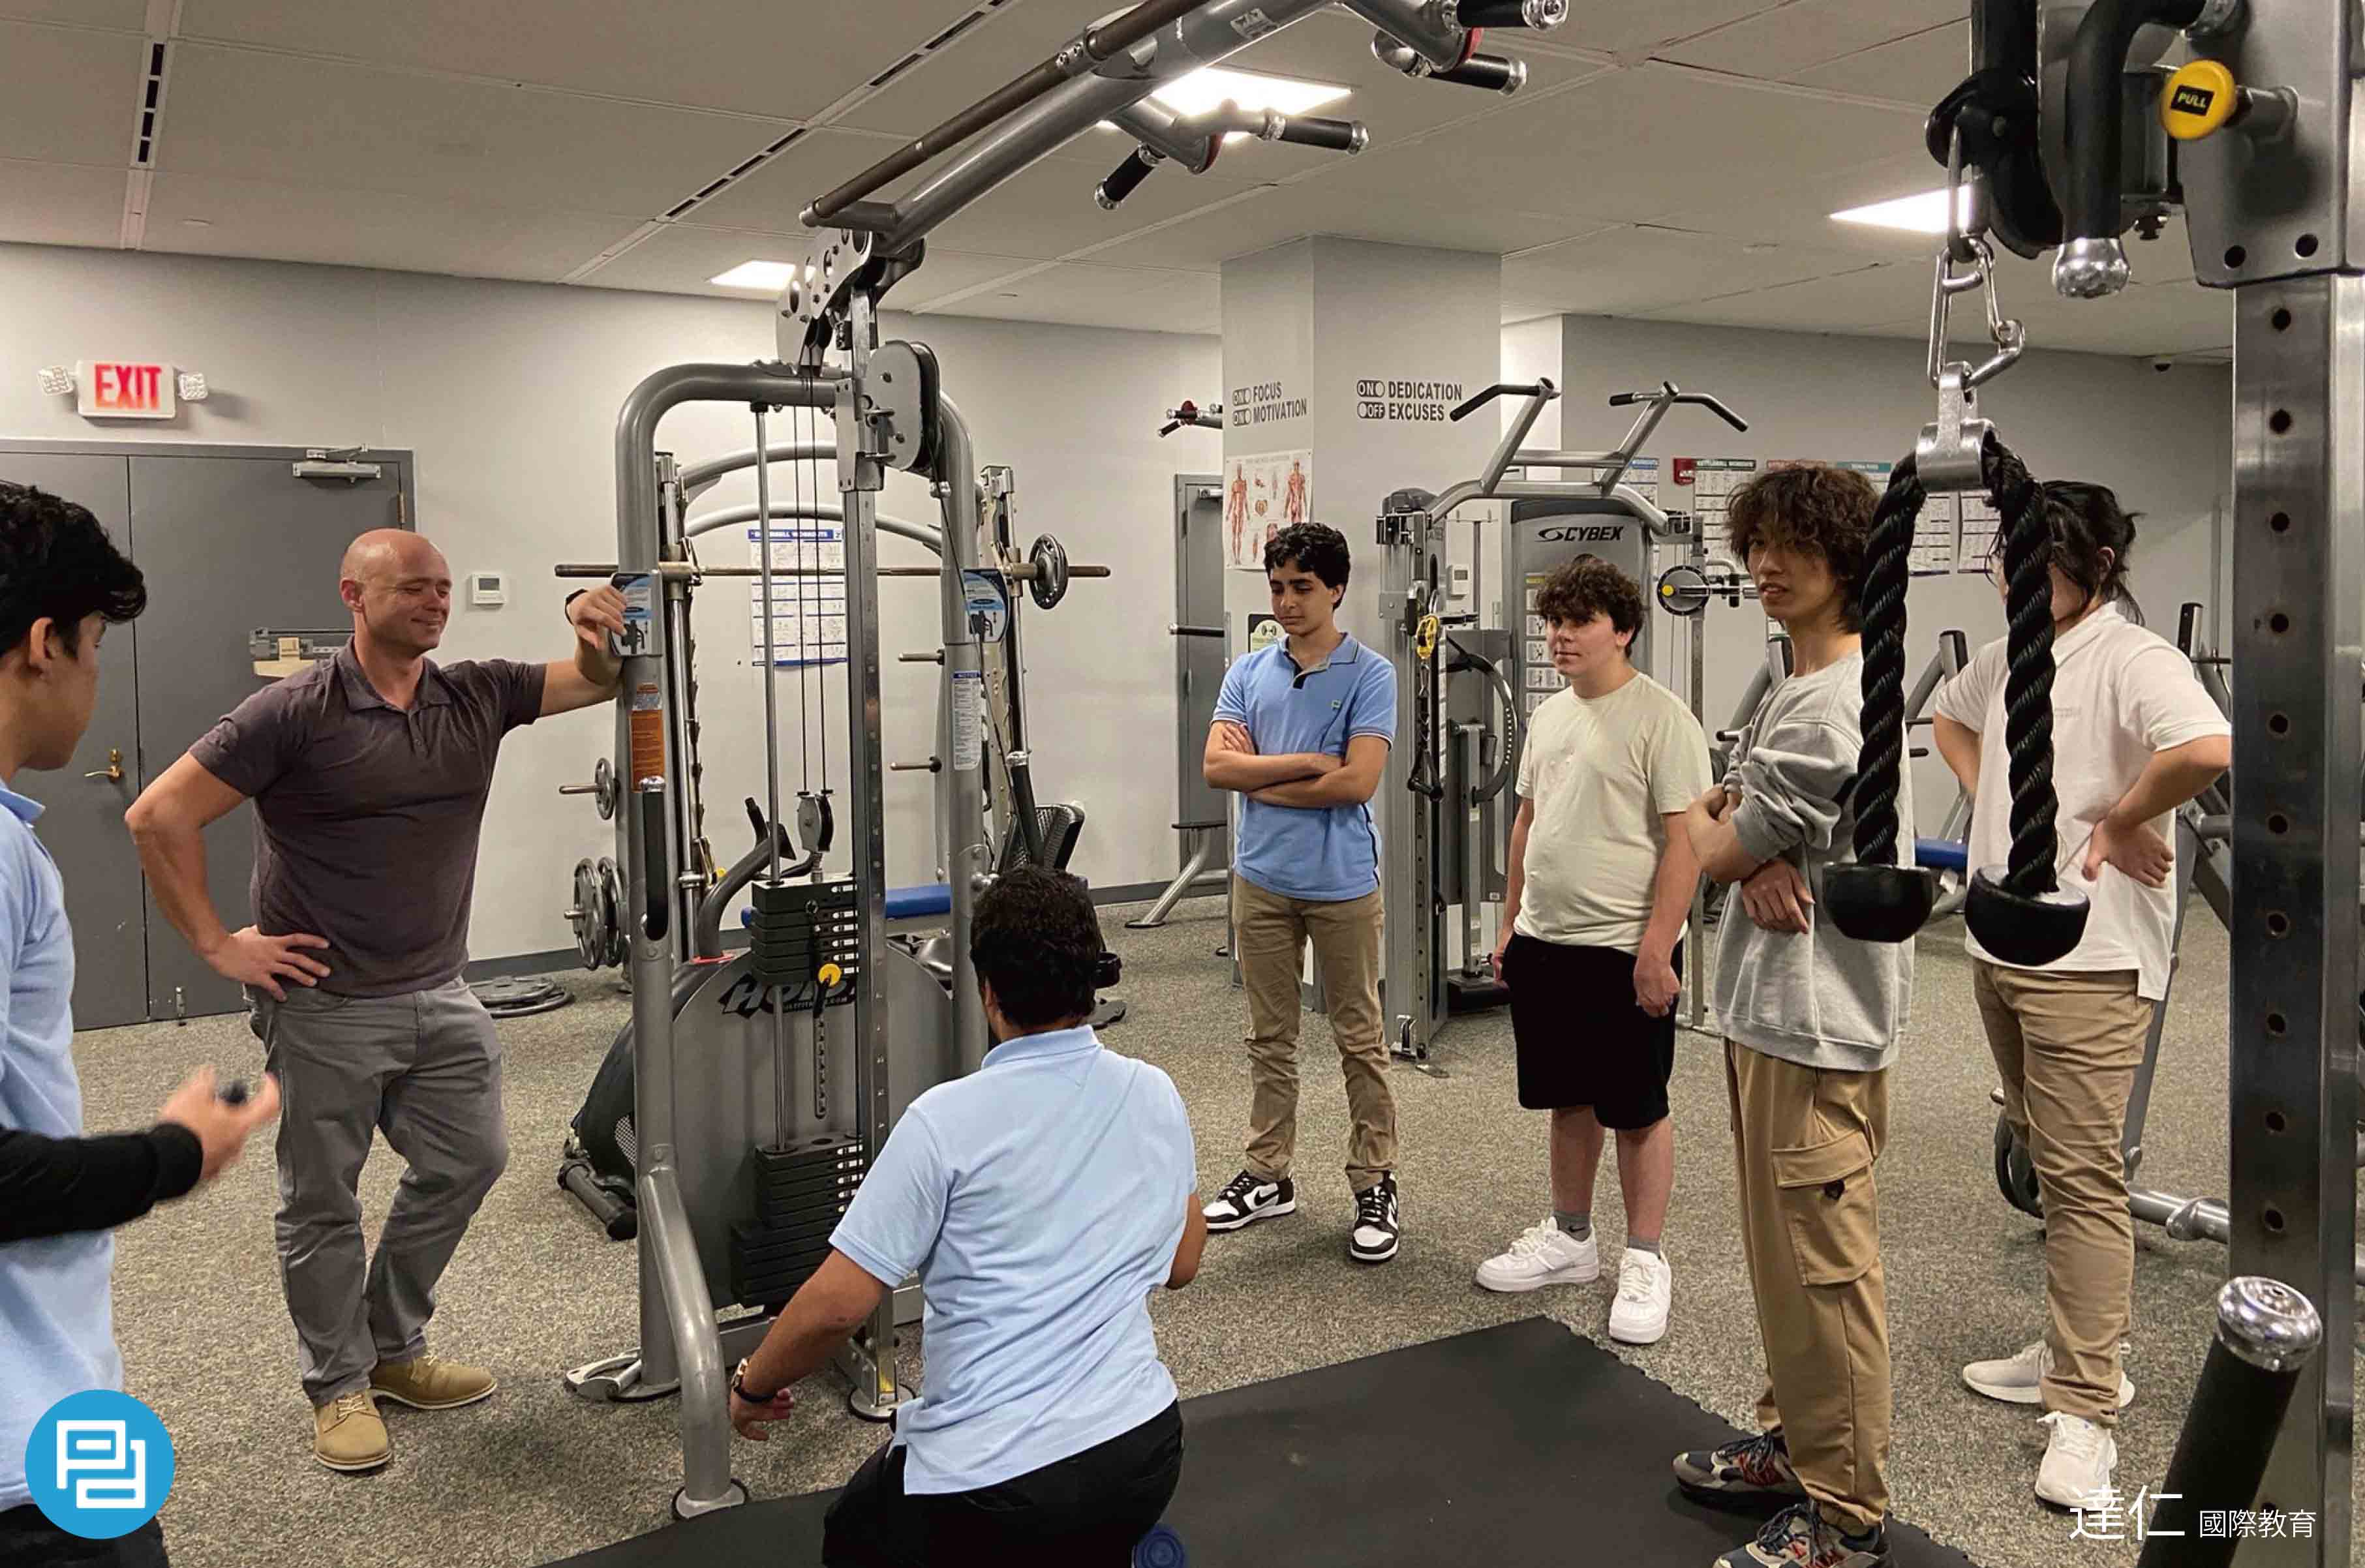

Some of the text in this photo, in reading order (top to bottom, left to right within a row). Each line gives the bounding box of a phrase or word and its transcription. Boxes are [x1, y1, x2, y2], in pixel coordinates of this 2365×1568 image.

[2177, 92, 2206, 108] PULL
[95, 363, 162, 410] EXIT
[1253, 381, 1282, 402] FOCUS
[1357, 381, 1462, 400] ON DEDICATION
[1253, 397, 1307, 423] MOTIVATION
[1367, 402, 1444, 421] OFF EXCUSES
[1564, 526, 1624, 541] CYBEX
